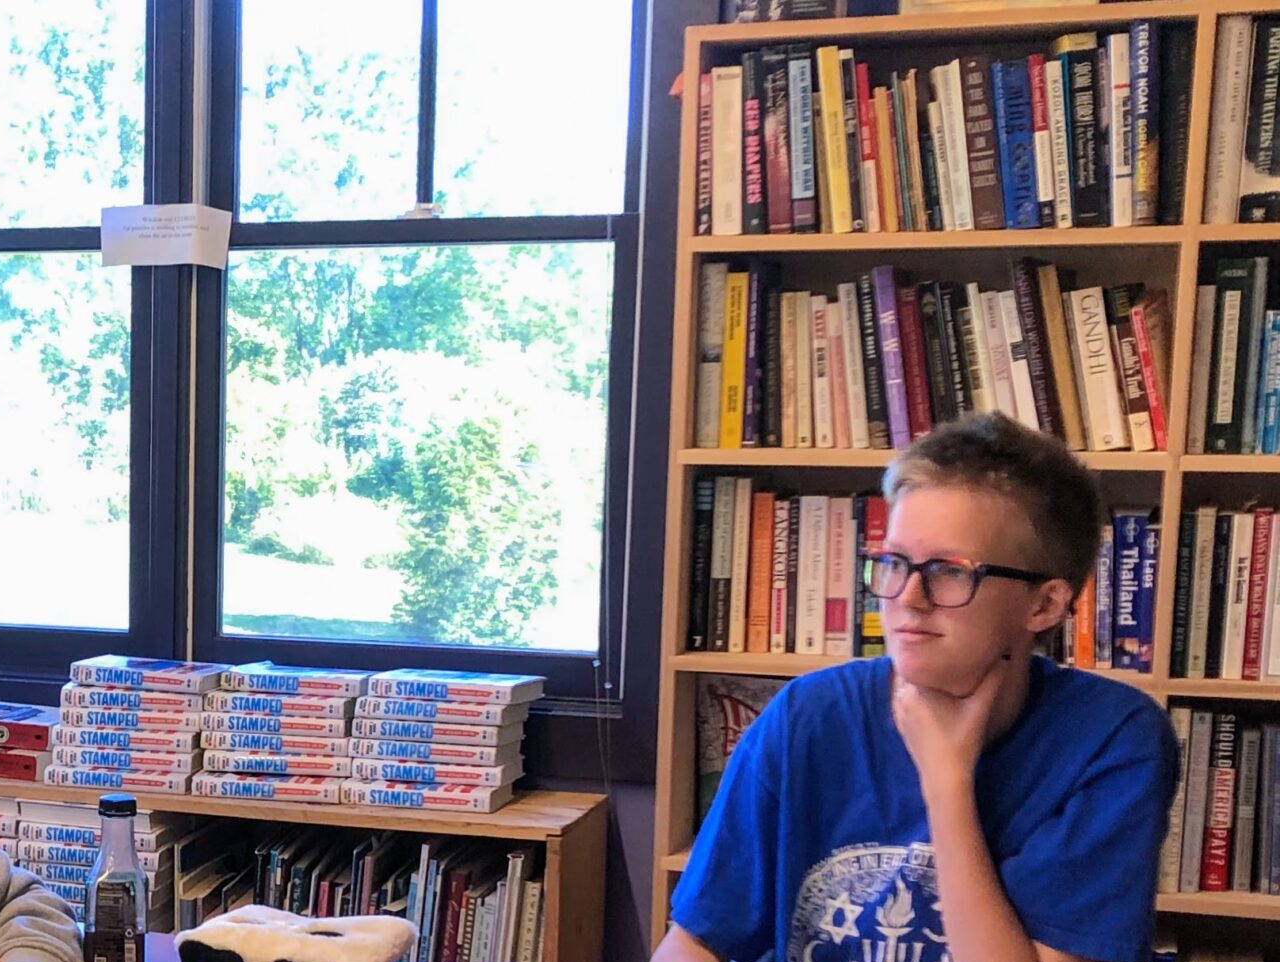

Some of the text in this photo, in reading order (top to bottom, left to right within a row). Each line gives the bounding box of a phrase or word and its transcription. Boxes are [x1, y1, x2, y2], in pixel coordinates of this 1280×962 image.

[1137, 23, 1149, 114] TREVOR NOAH
[1072, 62, 1094, 121] SOCIAL THEORY
[1260, 28, 1280, 149] PARTING THE WATERS
[801, 84, 810, 122] WORLD
[1052, 79, 1069, 204] KOZOL AMAZING GRACE
[1137, 118, 1148, 148] BORN
[745, 99, 761, 204] RED DIAPERS
[802, 125, 812, 164] WITHIN
[803, 168, 813, 192] WAR
[1137, 159, 1148, 191] CRIME
[1080, 294, 1108, 375] GANDHI
[1028, 331, 1044, 376] WOMEN
[1121, 337, 1145, 399] Gandhi's Truth
[1256, 514, 1271, 553] ARTISANS
[772, 511, 788, 583] ANGKOR
[1100, 557, 1110, 610] Cambodia
[1142, 559, 1156, 588] Laos
[1118, 546, 1140, 626] Thailand
[1251, 573, 1266, 615] WORKERS
[96, 668, 143, 686] STAMPED
[248, 674, 299, 691] STAMPED
[89, 692, 141, 708] STAMPED
[395, 681, 448, 699] STAMPED
[231, 697, 282, 713] STAMPED
[384, 700, 437, 718] STAMPED
[87, 711, 138, 727] STAMPED
[228, 716, 281, 732] STAMPED
[80, 731, 130, 747] STAMPED
[380, 722, 433, 739] STAMPED
[230, 734, 283, 750] STAMPED
[377, 742, 431, 759] STAMPED
[80, 751, 131, 767] STAMPED
[233, 757, 288, 772] STAMPED
[72, 771, 123, 788] STAMPED
[381, 764, 435, 781] STAMPED
[221, 782, 275, 798] STAMPED
[370, 790, 424, 807] STAMPED
[1210, 714, 1236, 866] SHOULD AMERICA PAY?
[46, 827, 95, 845] STAMPED
[48, 847, 99, 864] STAMPED
[46, 865, 90, 882] STAMPE
[528, 886, 537, 922] LEWIS
